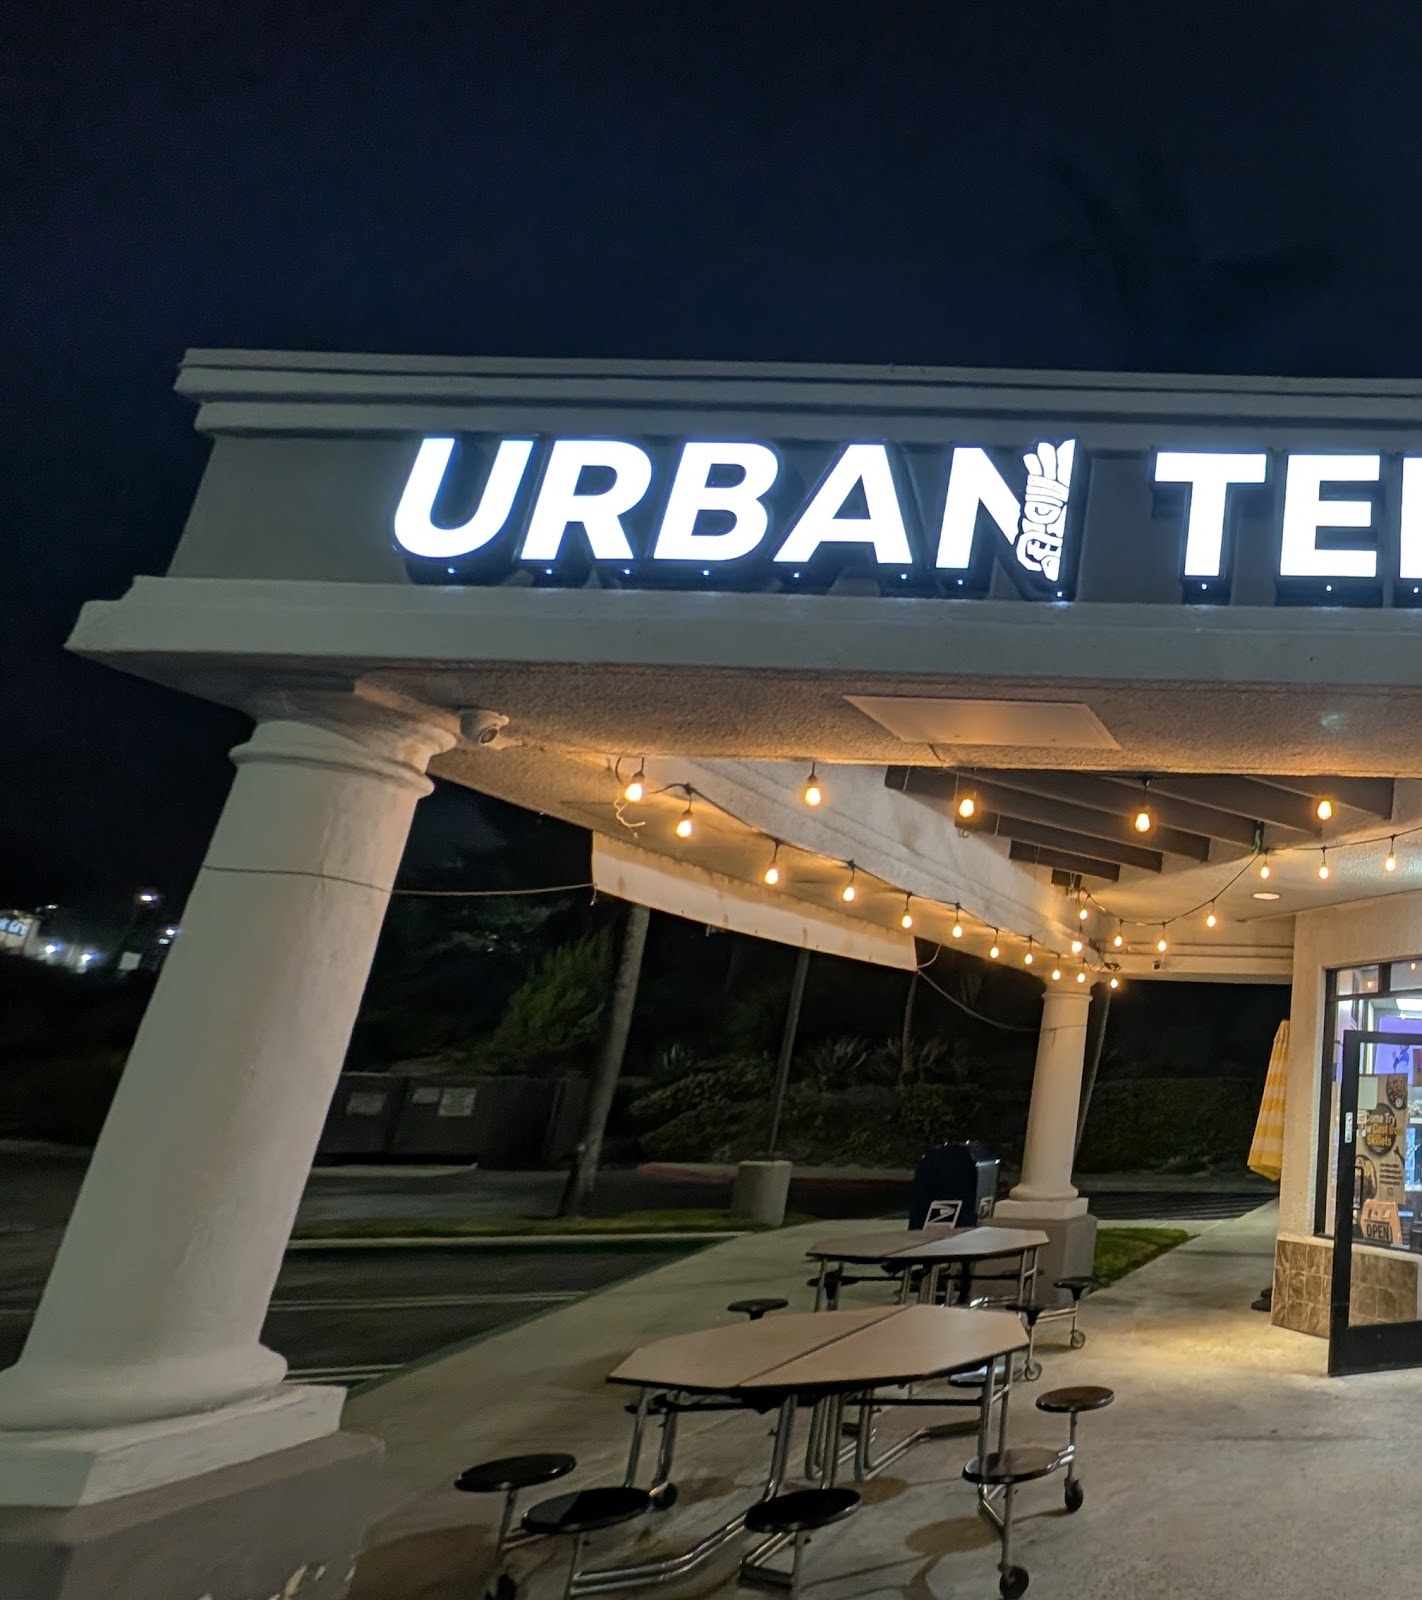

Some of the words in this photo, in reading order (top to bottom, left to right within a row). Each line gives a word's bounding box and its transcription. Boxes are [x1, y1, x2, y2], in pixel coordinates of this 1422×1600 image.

[393, 436, 1076, 583] URBAN
[1385, 1112, 1396, 1126] Try
[1366, 1223, 1389, 1241] OPEN
